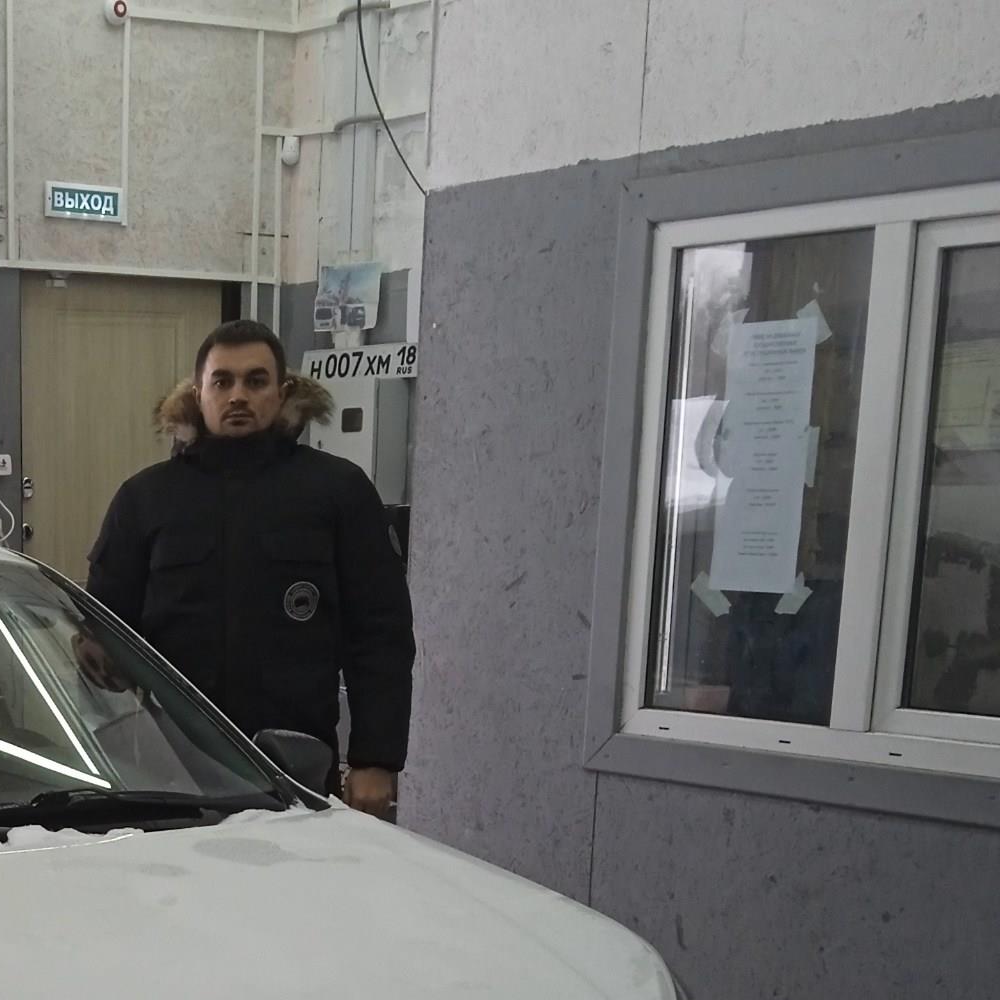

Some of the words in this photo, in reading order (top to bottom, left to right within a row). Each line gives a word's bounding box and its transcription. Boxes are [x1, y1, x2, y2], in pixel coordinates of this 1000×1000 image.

[53, 191, 114, 215] ВЫХОД
[397, 345, 417, 366] 18
[396, 366, 413, 375] RUS
